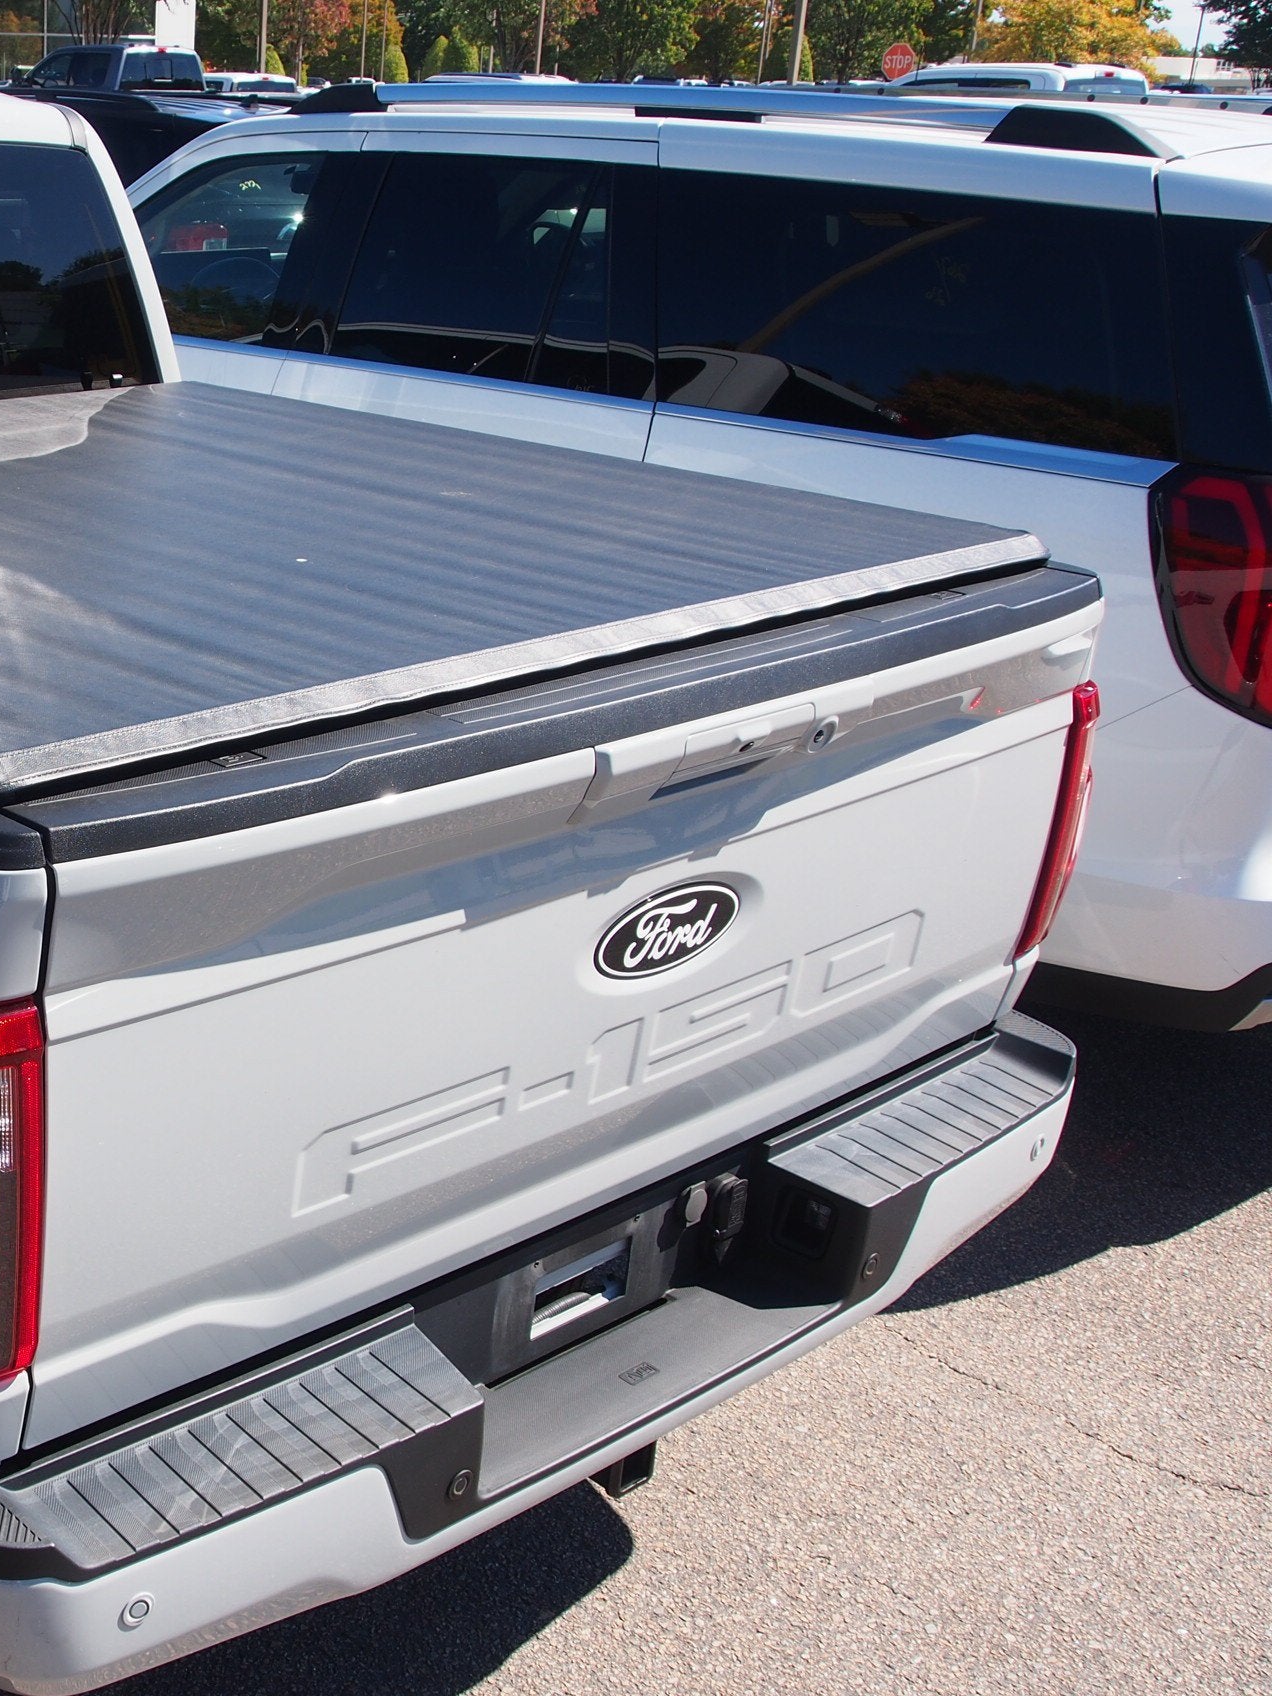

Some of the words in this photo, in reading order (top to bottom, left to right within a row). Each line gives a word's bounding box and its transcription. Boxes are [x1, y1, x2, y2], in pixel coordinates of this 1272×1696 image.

[884, 55, 912, 69] STOP
[621, 896, 721, 970] Ford
[291, 907, 924, 1217] F-150
